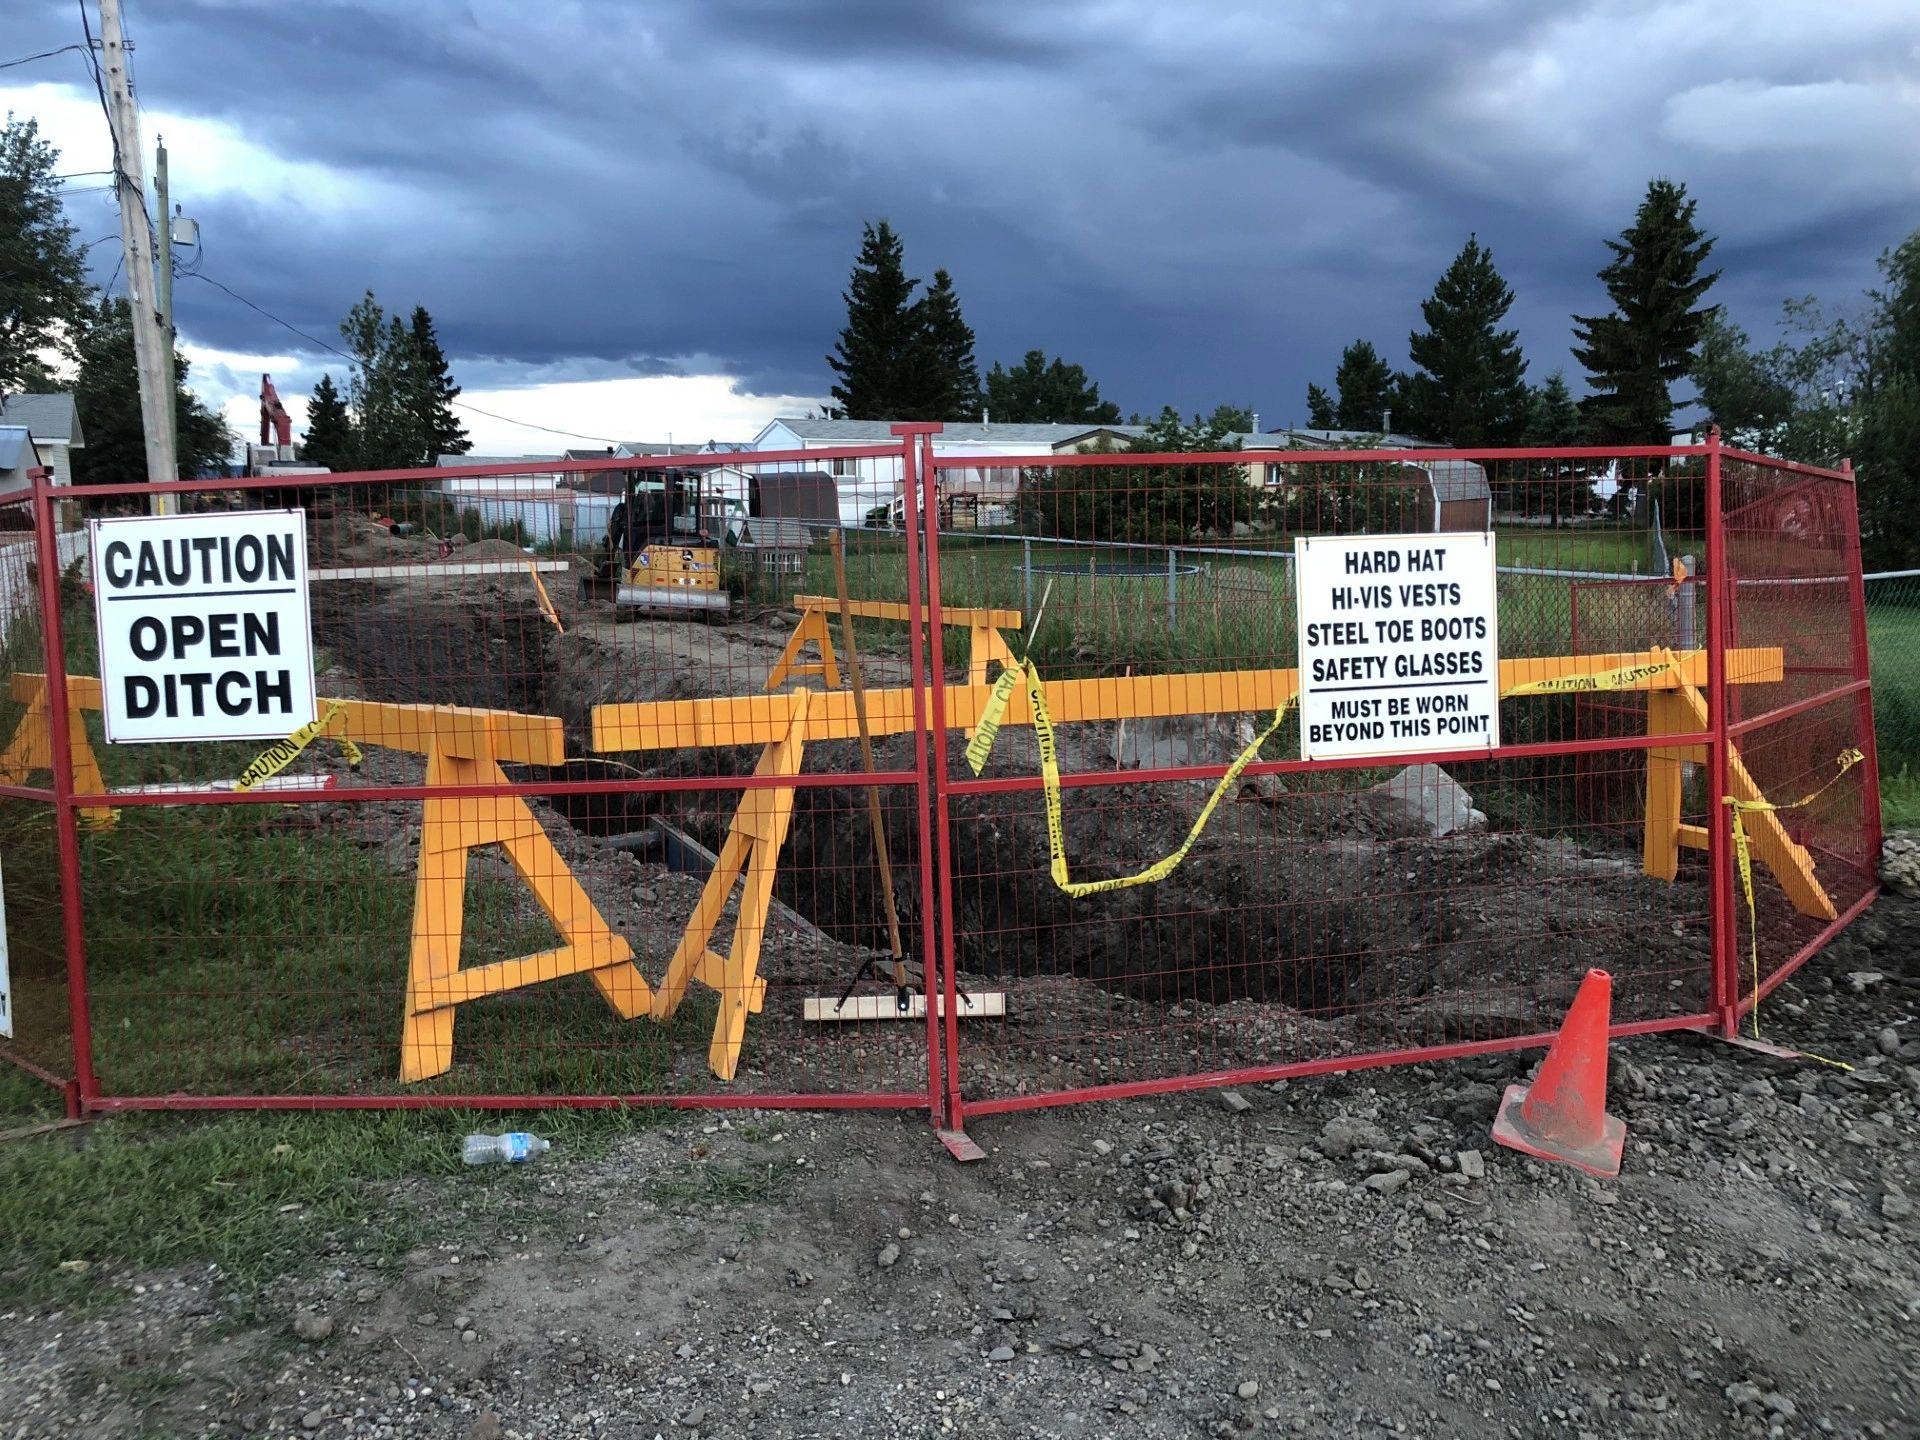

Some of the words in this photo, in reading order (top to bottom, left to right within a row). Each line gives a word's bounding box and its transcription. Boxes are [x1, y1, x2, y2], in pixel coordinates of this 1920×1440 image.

[104, 533, 296, 589] CAUTION
[1345, 551, 1401, 575] HARD
[1407, 549, 1446, 572] HAT
[1331, 585, 1393, 611] HI-VIS
[1398, 582, 1461, 608] VESTS
[129, 611, 281, 662] OPEN
[1307, 621, 1370, 647] STEEL
[1374, 619, 1414, 644] TOE
[1421, 615, 1487, 642] BOOTS
[1312, 655, 1388, 683] SAFETY
[1394, 650, 1483, 678] GLASSES
[123, 669, 293, 719] DITCH
[1331, 699, 1382, 720] MUST
[1387, 697, 1411, 716] BE
[1415, 694, 1469, 715] WORN
[1309, 721, 1385, 744] BEYOND
[1389, 717, 1431, 738] THIS
[1436, 714, 1490, 736] POINT
[240, 738, 300, 787] CAUTION
